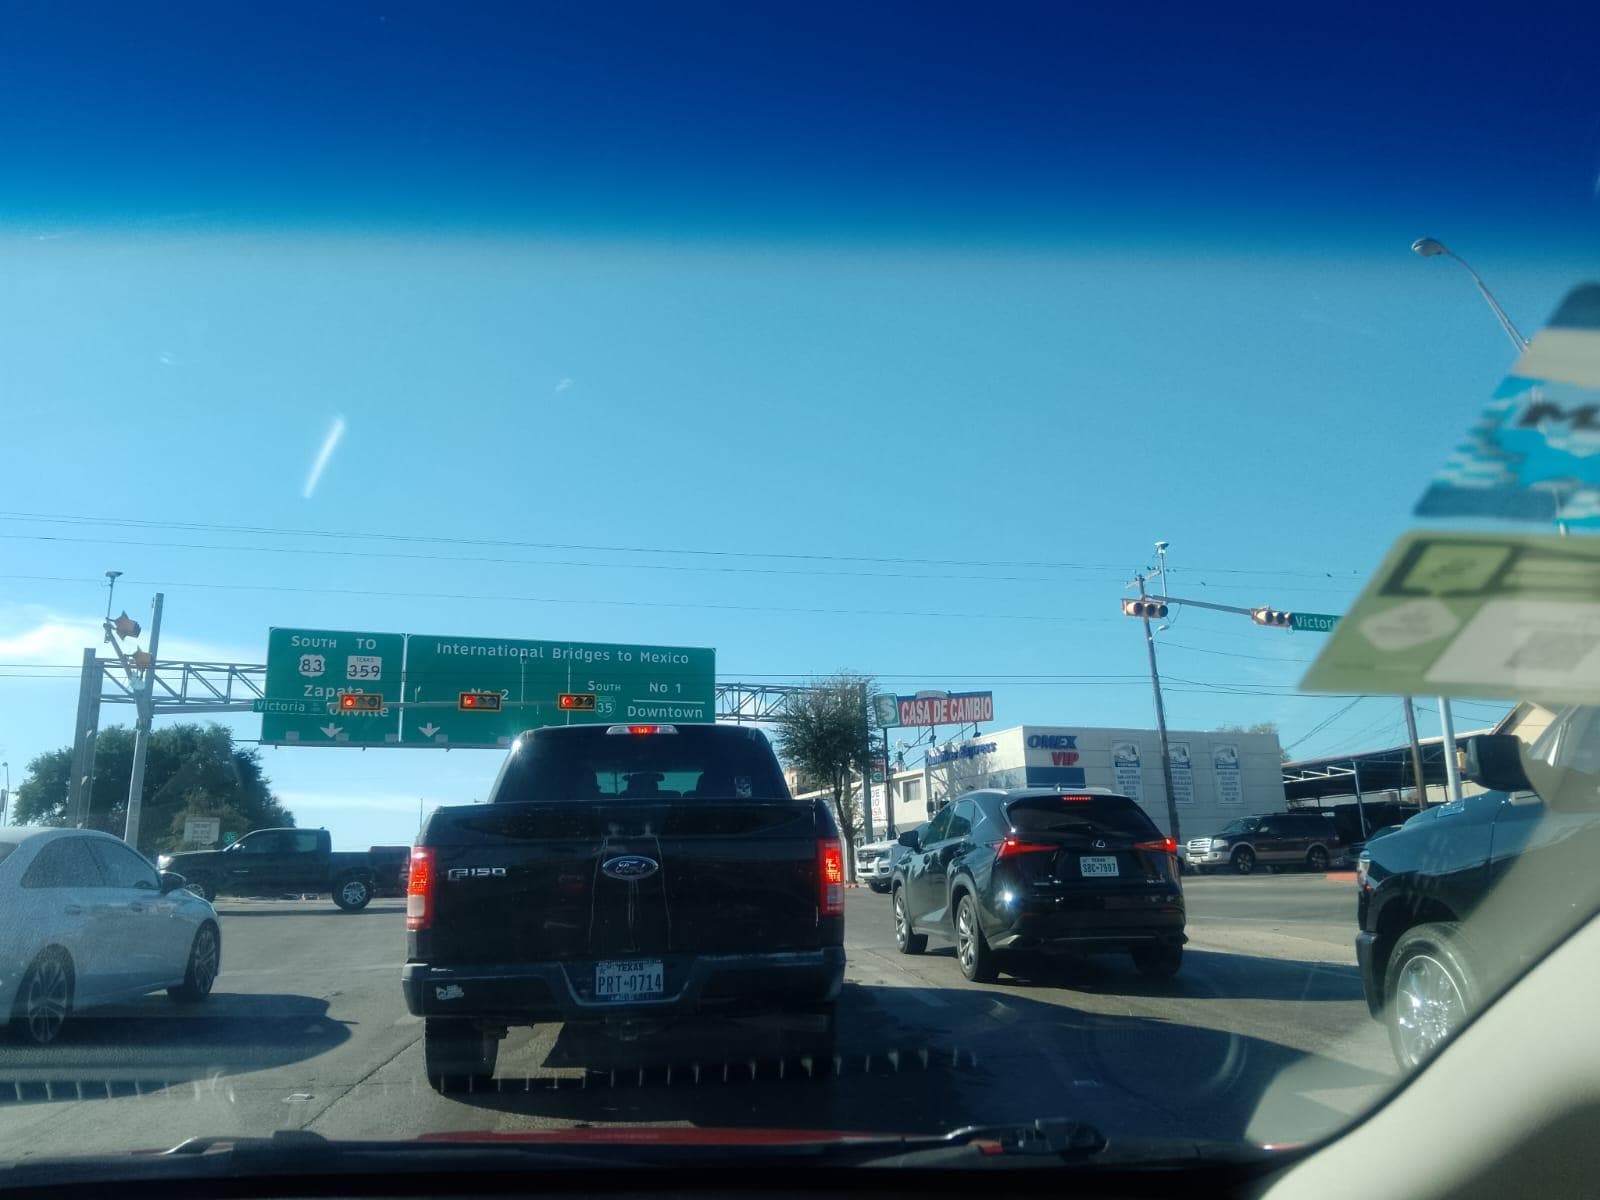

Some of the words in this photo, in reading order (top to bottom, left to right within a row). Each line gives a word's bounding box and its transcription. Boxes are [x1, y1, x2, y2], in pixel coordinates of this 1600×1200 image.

[1295, 615, 1336, 629] Victori
[291, 635, 337, 648] SOUTH
[356, 638, 377, 650] TO
[436, 643, 544, 659] International
[552, 648, 611, 664] Bridges
[617, 650, 632, 662] to
[640, 651, 689, 665] Mexico
[301, 659, 323, 672] 83
[348, 665, 381, 678] 359
[587, 680, 621, 692] SOUTH
[650, 682, 668, 693] No
[675, 683, 682, 693] 1
[501, 688, 510, 700] 2
[256, 701, 306, 712] Victoria
[597, 703, 613, 714] 35
[627, 706, 703, 718] Downtown
[901, 700, 931, 725] CASA
[933, 700, 948, 722] DE
[950, 697, 992, 721] CAMBIO
[1027, 734, 1077, 749] OMEX
[1051, 752, 1079, 766] VIP
[615, 860, 646, 874] Ford
[618, 964, 644, 972] TEXAS
